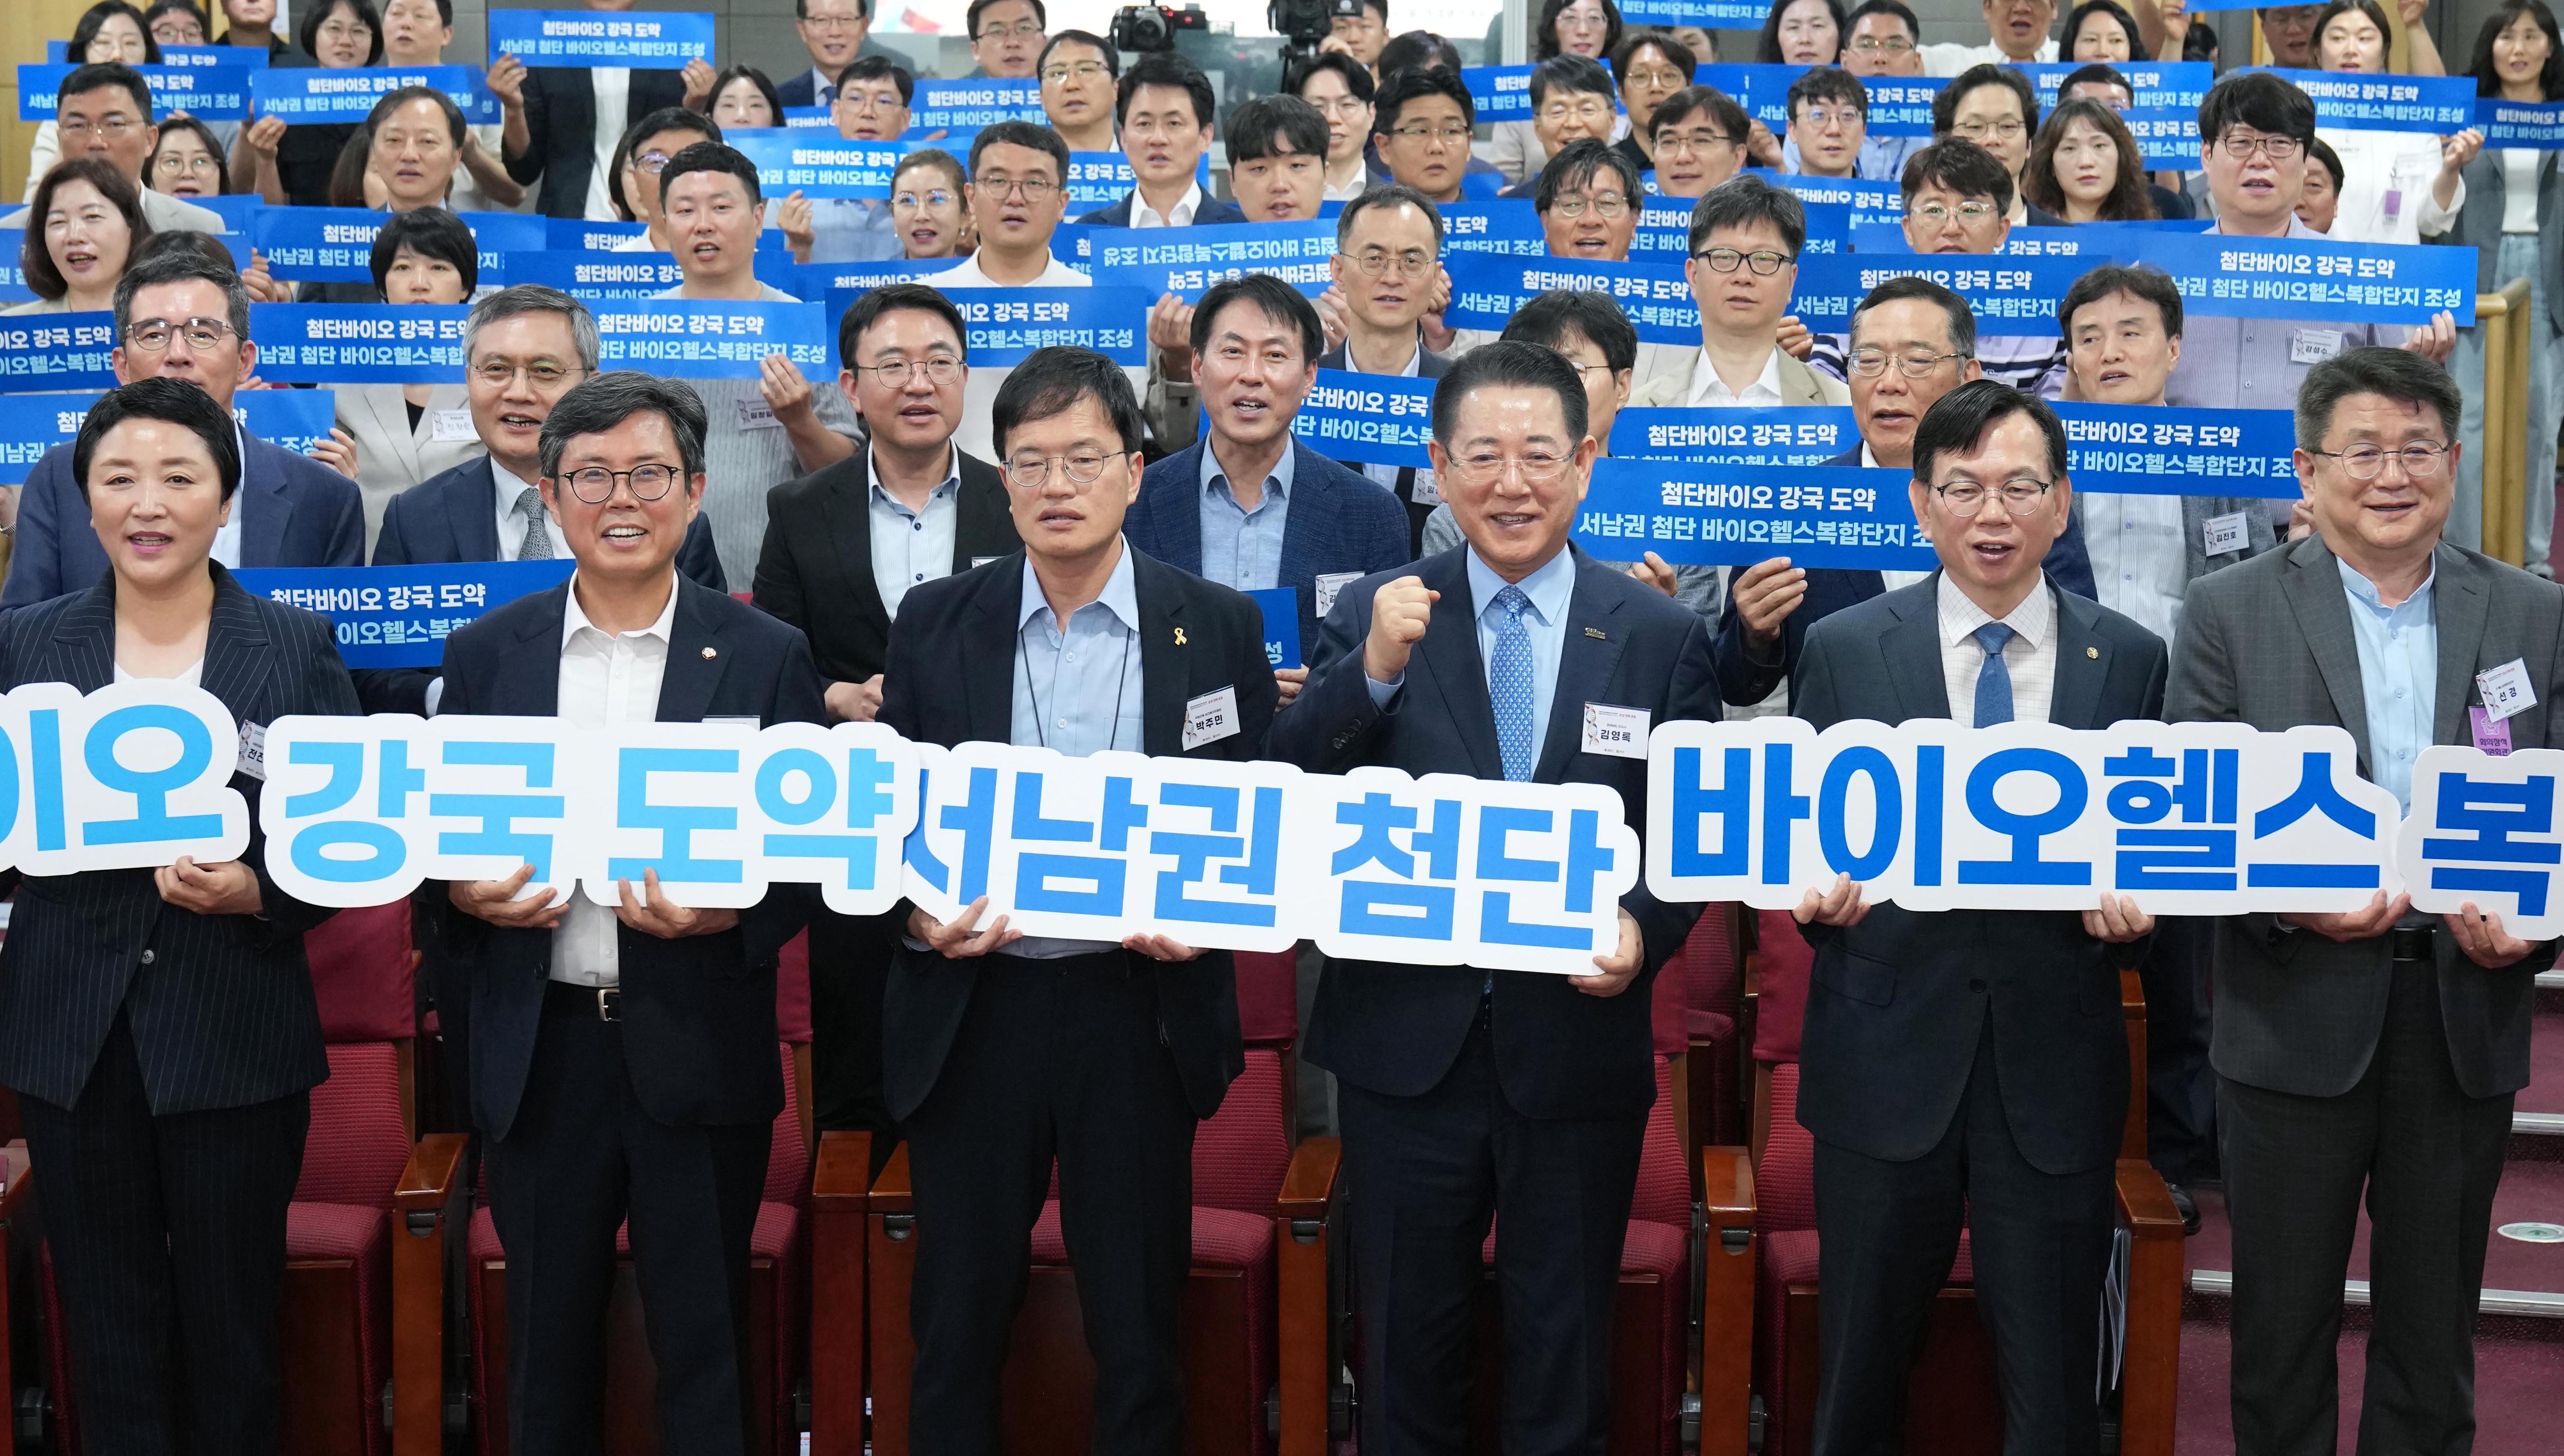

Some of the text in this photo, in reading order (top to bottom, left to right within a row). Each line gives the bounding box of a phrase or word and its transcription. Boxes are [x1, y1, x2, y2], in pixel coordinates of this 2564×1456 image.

[543, 21, 660, 37] 첨단바이오 강국 도약
[567, 42, 677, 56] 바이오헬스복합단지
[681, 43, 704, 59] 조성
[167, 75, 194, 89] 도약
[307, 78, 371, 93] 첨단바이오
[373, 76, 400, 92] 강국
[2133, 73, 2159, 87] 도약
[152, 95, 211, 111] 스복합단지
[216, 94, 239, 108] 조성
[927, 90, 1042, 106] 첨단바이오 강국 도
[1877, 88, 1904, 103] 강국
[2362, 84, 2389, 100] 강국
[2391, 85, 2418, 101] 도약
[264, 99, 300, 112] 서남권
[305, 98, 329, 111] 첨단
[2317, 101, 2464, 122] 바이오헬스복합단지 조성
[925, 113, 949, 126] 첨단
[2153, 121, 2200, 137] 강국 도
[790, 148, 897, 169] 첨단바이오 강국
[757, 169, 892, 186] 남권 첨단 바이오헬스
[1085, 164, 1114, 180] 강국
[1855, 192, 1884, 209] 강국
[1886, 192, 1903, 210] 도
[324, 224, 380, 244] 첨단바
[1455, 216, 1488, 234] 도약
[1104, 247, 1137, 266] 조성
[1143, 240, 1301, 267] 바이오헬스복합단지
[1514, 237, 1547, 256] 조성
[267, 248, 313, 268] 서남권
[318, 249, 350, 266] 첨단
[2221, 251, 2395, 279] 첨단바이오 강국 도약
[575, 265, 654, 282] 첨단바이오
[1168, 271, 1203, 292] 도약
[1955, 271, 1991, 290] 강국
[1995, 271, 2032, 290] 도약
[1612, 278, 1649, 298] 강국
[1653, 279, 1691, 301] 도약
[2173, 277, 2461, 311] 남권 첨단 바이오헬스복합단지 조성
[994, 303, 1029, 322] 강국
[1034, 303, 1069, 321] 도약
[1458, 293, 1510, 313] 서남권
[1793, 296, 2056, 317] 서남권 스복합단지
[307, 319, 395, 339] 첨단바이오
[400, 320, 435, 339] 강국
[597, 314, 764, 335] 첨단바이오 강국 도약
[33, 328, 70, 348] 강국
[75, 326, 111, 345] 도약
[968, 329, 1132, 348] 오헬스복합단지 조성
[259, 344, 465, 369] 남권 첨단 바이오헬스복합
[630, 341, 788, 364] 바이오헬스복합단지
[790, 345, 826, 367] 조성
[1299, 385, 1428, 417] 단바이오 강국
[1320, 418, 1434, 448] 바이오헬스복
[1649, 424, 1837, 446] 첨단바이오 강국 도약
[2153, 424, 2193, 446] 강국
[2198, 426, 2240, 447] 도약
[2084, 451, 2266, 477] 바이오헬스복합단지
[1661, 481, 1876, 512] 첨단바이오 강국 도약
[1579, 513, 1936, 550] 서남권 첨단 바이오헬스복합단지 조
[388, 585, 434, 610] 강국
[441, 583, 486, 608] 도약
[336, 617, 476, 646] 이오헬스복
[1265, 641, 1282, 664] 성
[1196, 714, 1223, 730] 박주민
[1601, 729, 1631, 742] 김영록
[285, 741, 895, 891] 강국 도약
[1670, 742, 2562, 918] 바이오헬스 복
[902, 767, 1615, 951] 서남권 첨단
